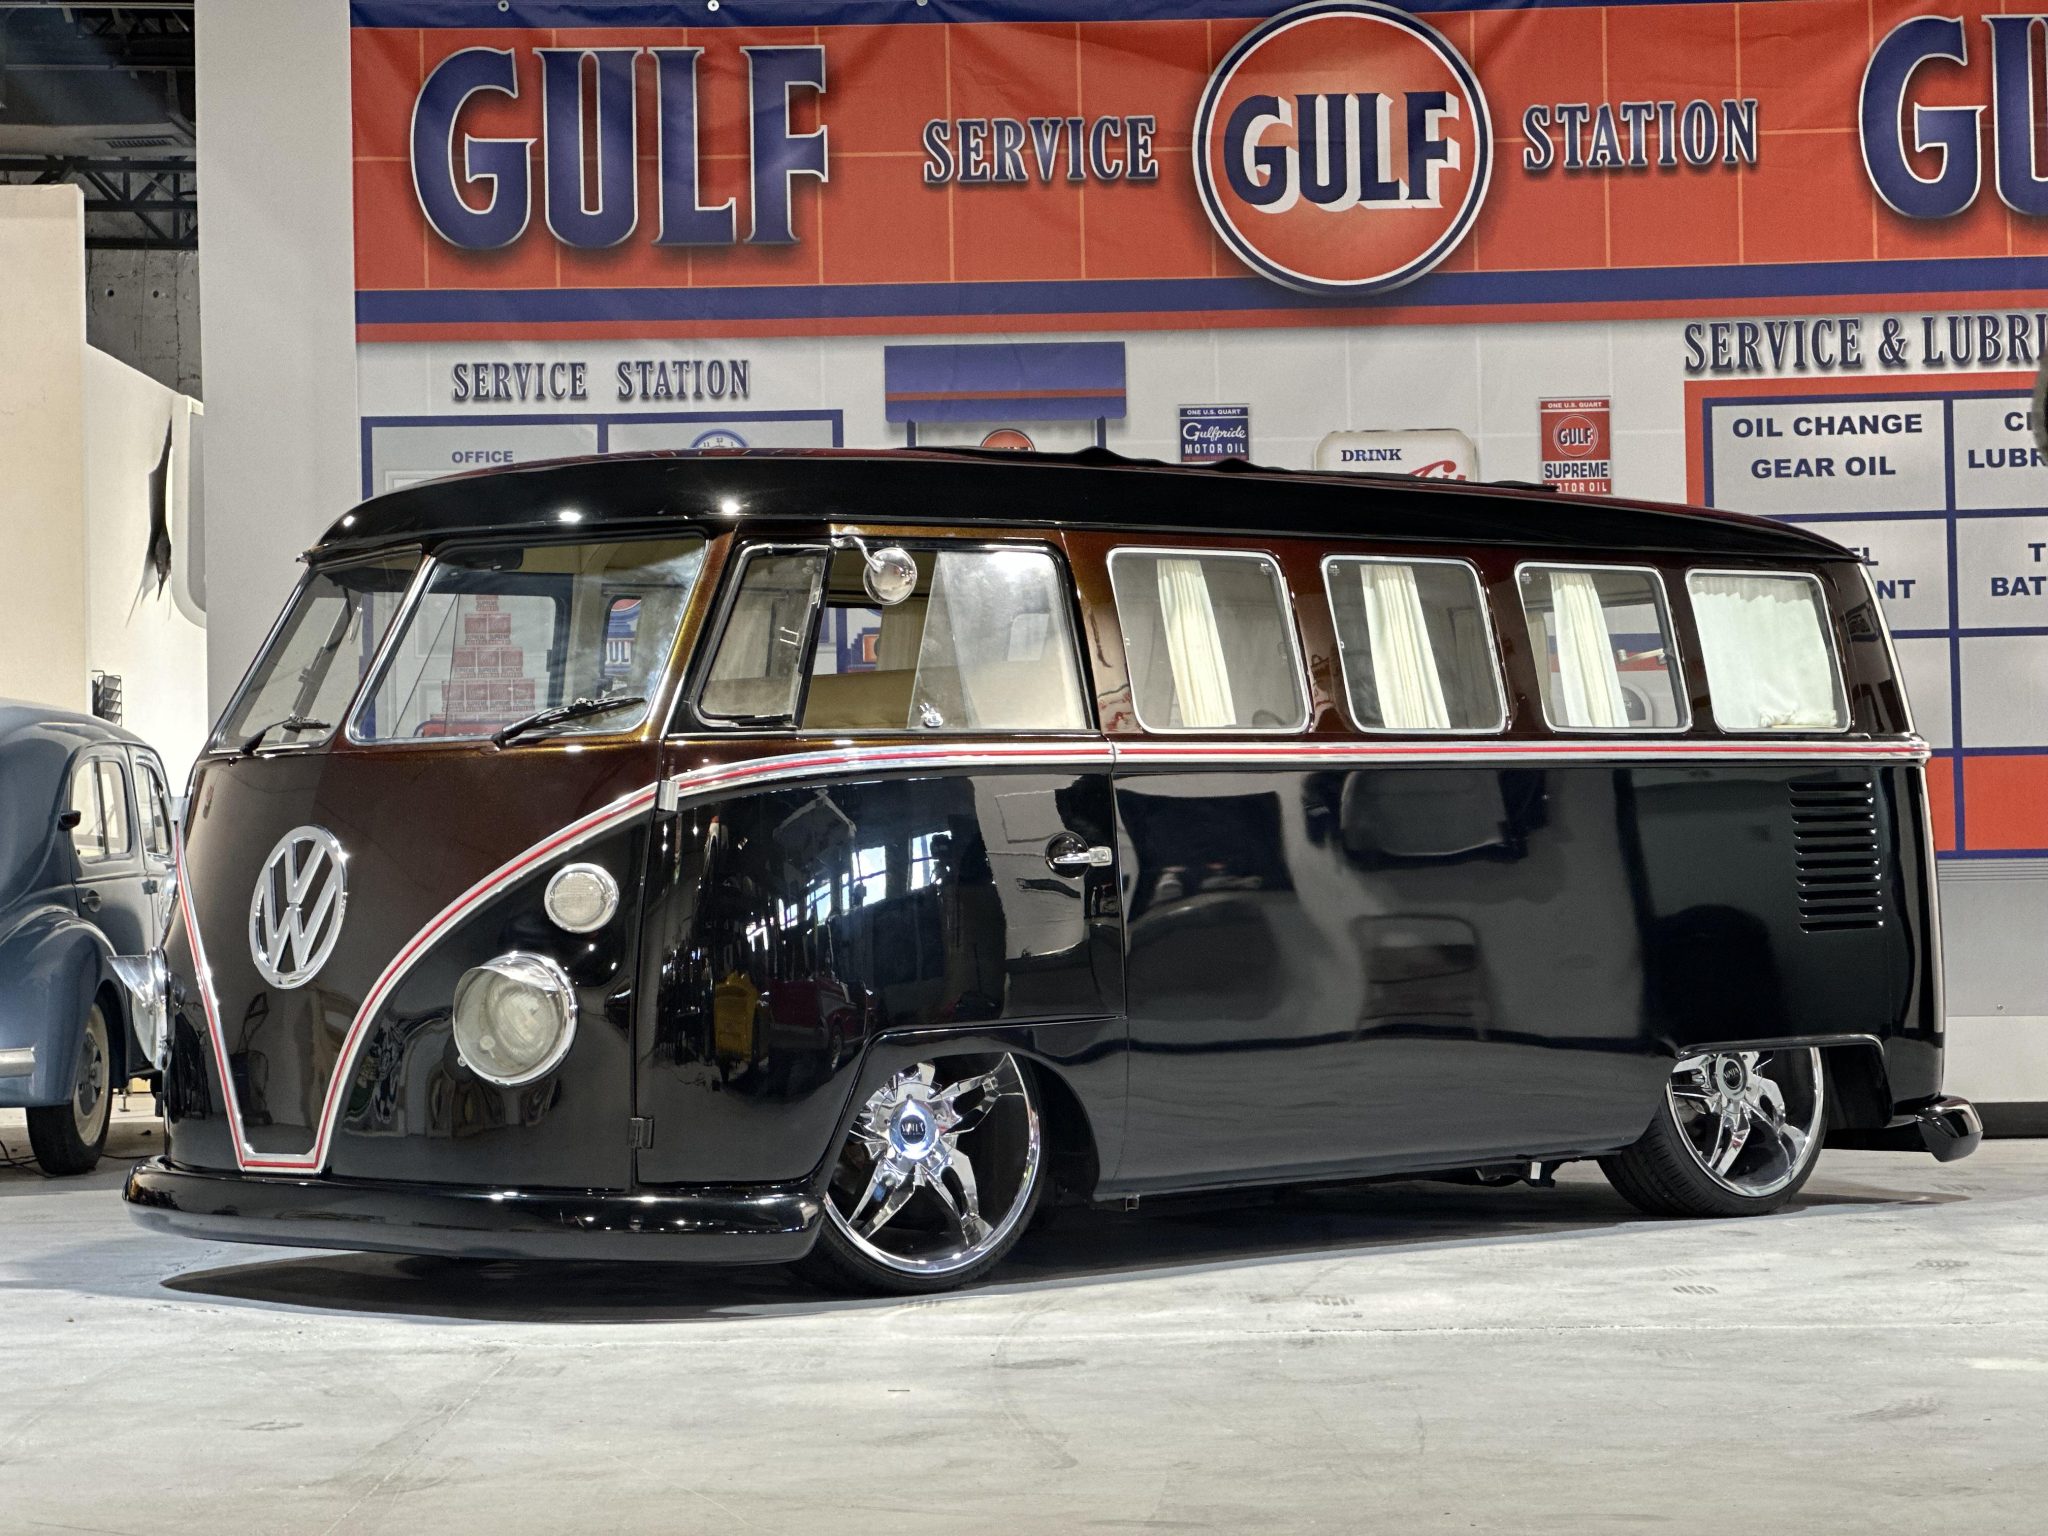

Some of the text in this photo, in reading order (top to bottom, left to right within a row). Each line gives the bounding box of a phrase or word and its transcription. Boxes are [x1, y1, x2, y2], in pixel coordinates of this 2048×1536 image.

[1858, 14, 2048, 219] GU
[1523, 98, 1758, 170] STATION
[410, 46, 829, 250] GULF
[923, 115, 1160, 184] SERVICE
[1223, 91, 1460, 214] GULF
[1684, 313, 2047, 372] SERVICE & LUBRI
[453, 360, 750, 401] SERVICE STATION
[1182, 422, 1247, 442] Gulfpride
[1733, 414, 1922, 437] OIL CHANGE
[1184, 443, 1245, 454] MOTOR OIL
[1558, 428, 1593, 447] GULF
[452, 451, 514, 464] OFFICE
[1341, 449, 1402, 462] DRINK
[1544, 462, 1608, 479] SUPREME
[1751, 456, 1896, 478] GEAR OIL
[1547, 482, 1607, 493] OTOR OIL
[1991, 576, 2046, 596] BAT
[249, 826, 348, 989] VW
